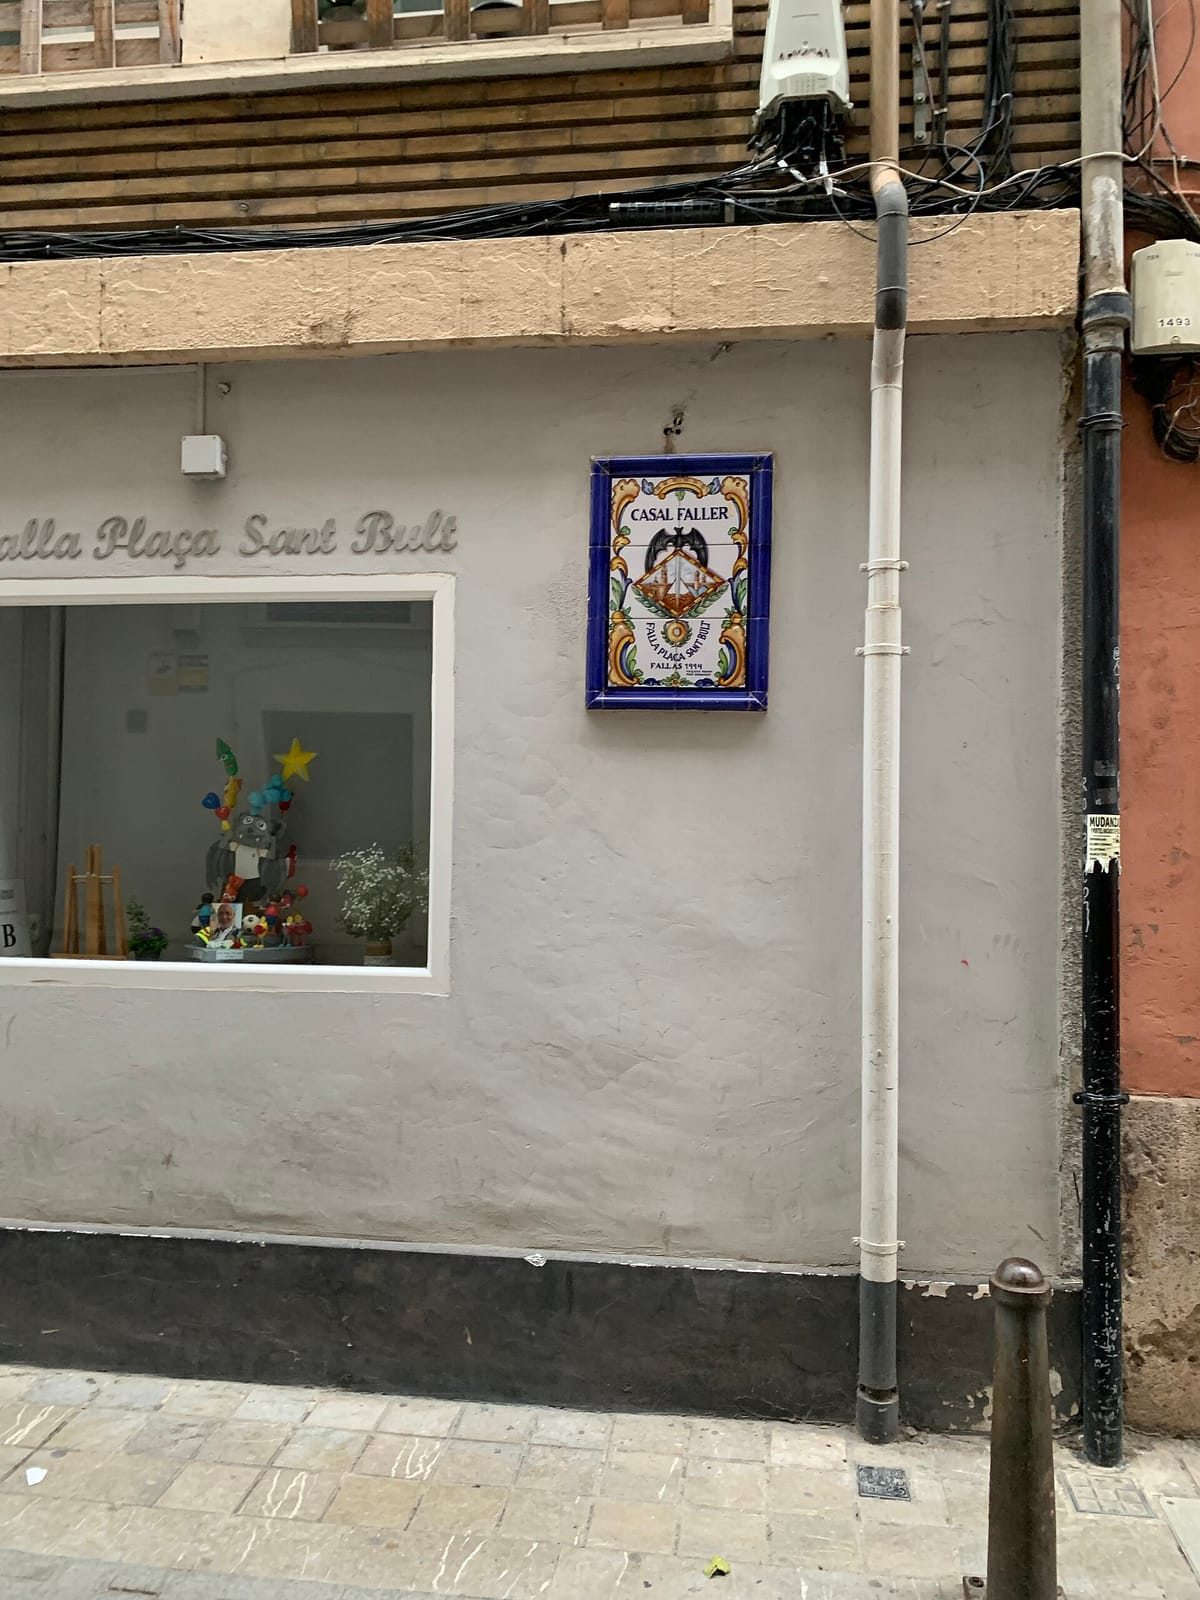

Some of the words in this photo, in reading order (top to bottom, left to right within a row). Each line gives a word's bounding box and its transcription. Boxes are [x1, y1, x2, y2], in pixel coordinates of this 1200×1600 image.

[1159, 317, 1191, 327] 1493
[631, 507, 673, 521] CASAL
[677, 506, 729, 520] FALLER
[93, 515, 221, 569] Plaça
[238, 512, 337, 557] Sant
[350, 508, 458, 554] Bult
[646, 622, 660, 651] FALLA
[685, 638, 703, 658] SANT
[697, 620, 711, 641] BULT
[650, 662, 682, 670] FALLAS
